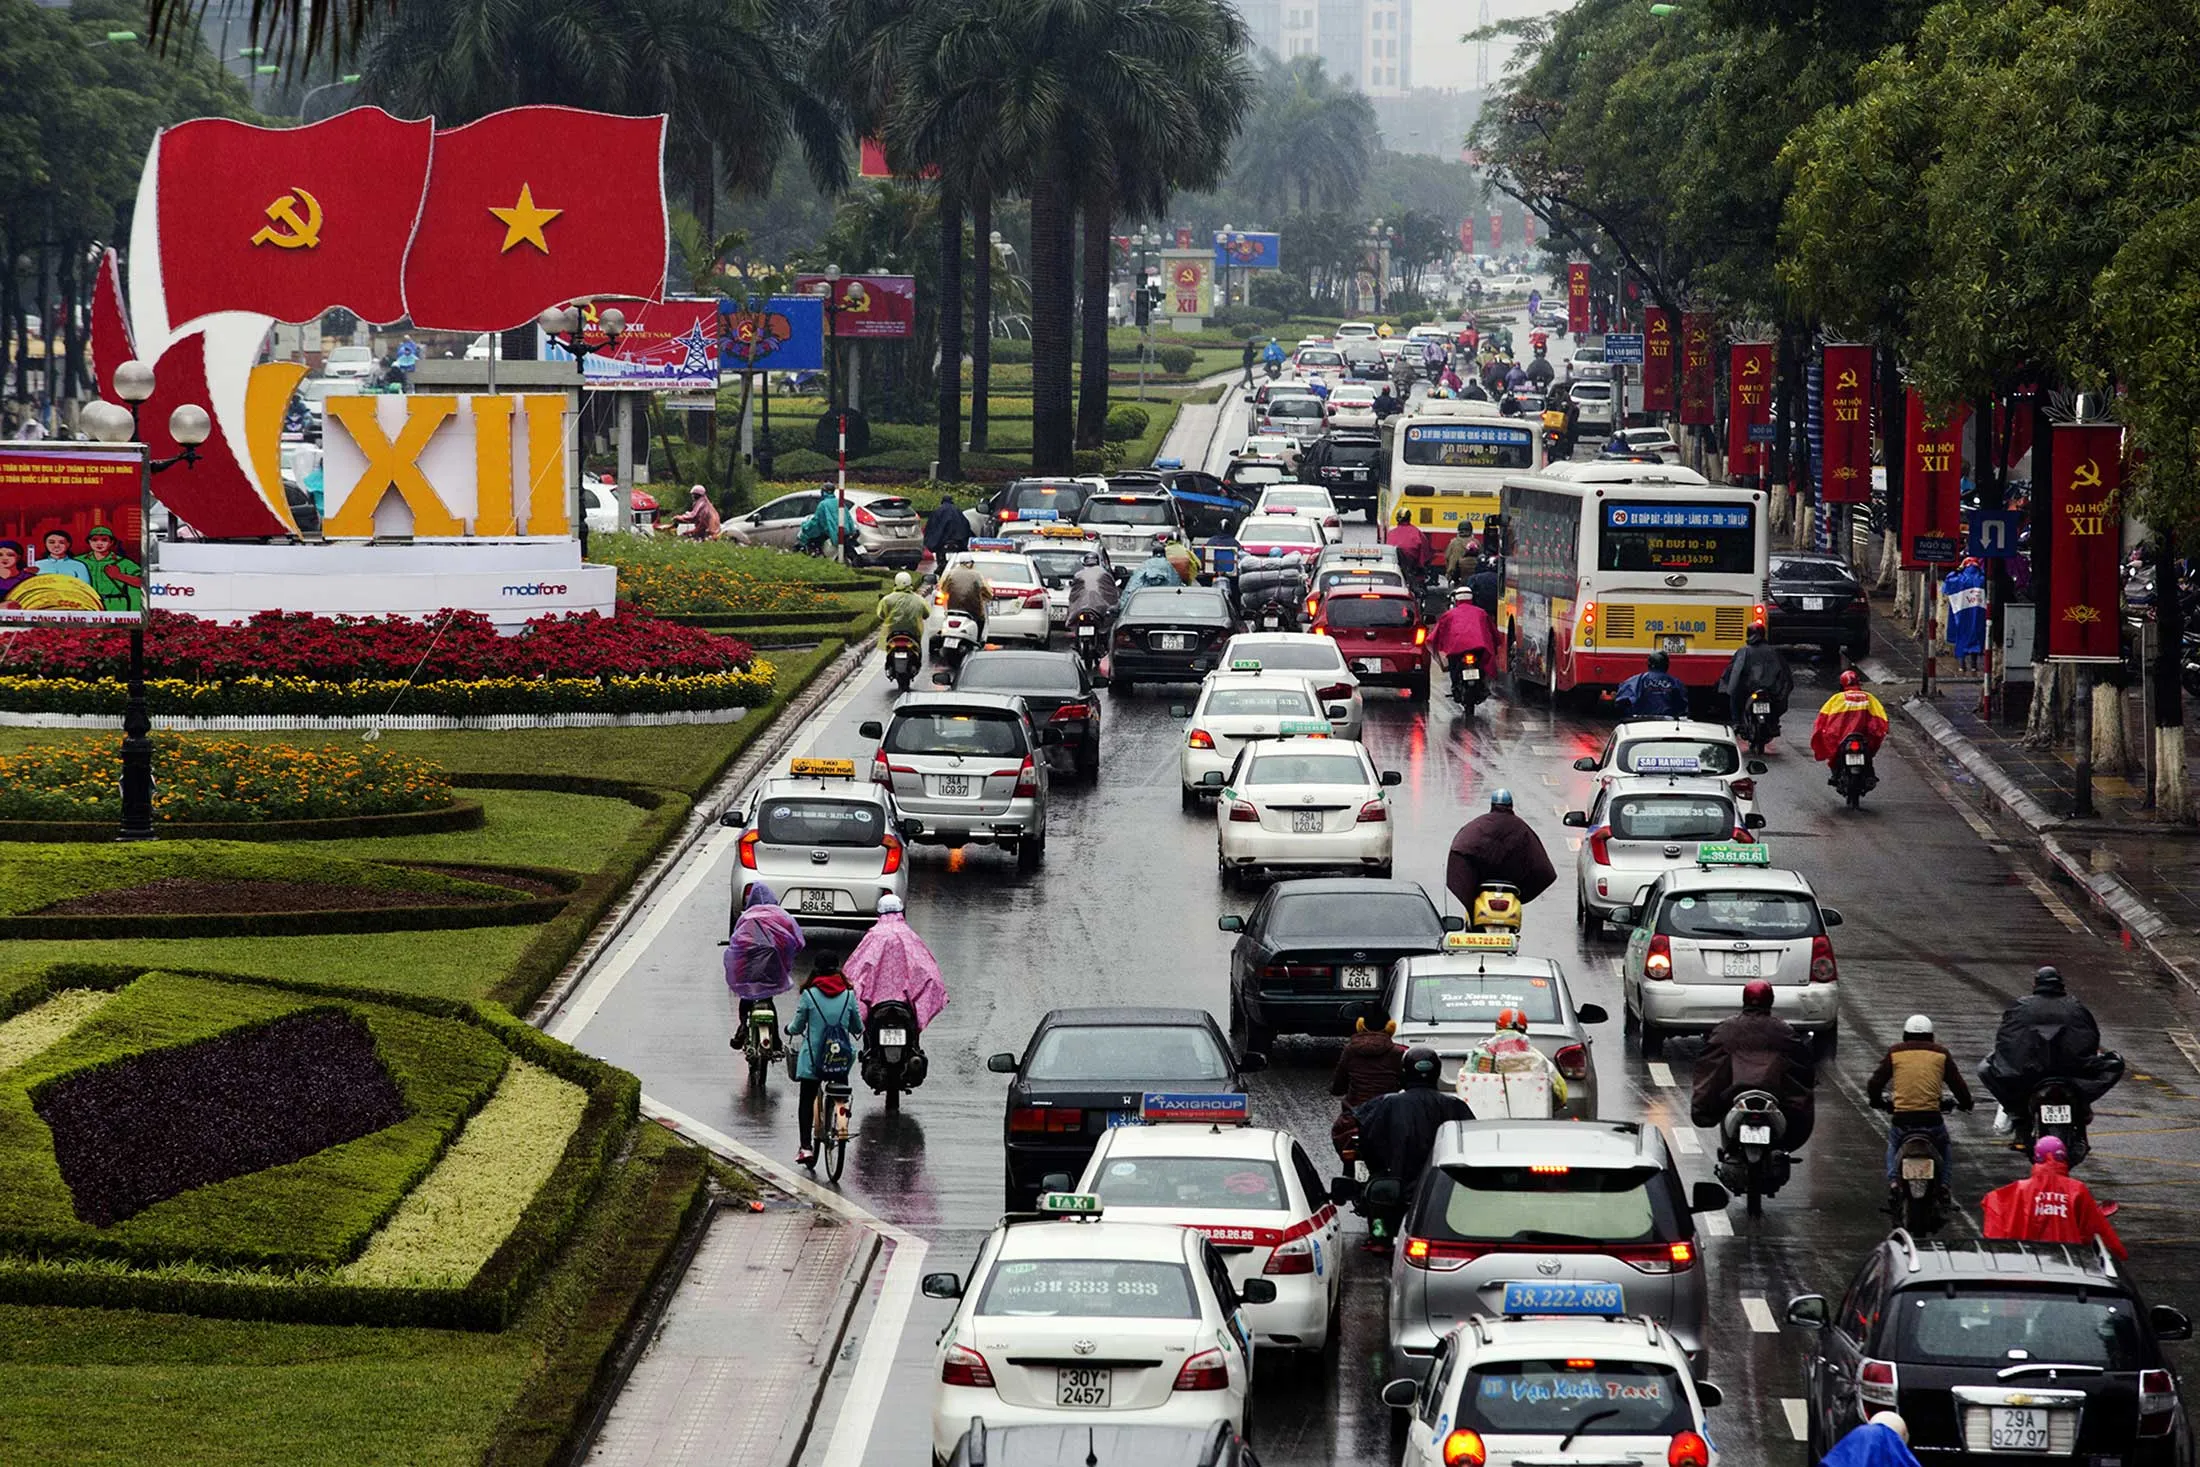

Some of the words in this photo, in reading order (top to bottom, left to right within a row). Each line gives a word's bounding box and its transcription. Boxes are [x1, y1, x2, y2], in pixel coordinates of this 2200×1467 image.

[1177, 299, 1197, 312] XII
[1651, 346, 1668, 356] XII
[1742, 393, 1760, 404] XII
[1835, 408, 1859, 421] XII
[1917, 443, 1935, 455] ĐẠI
[1937, 443, 1955, 455] HỘI
[324, 395, 570, 537] XII
[1921, 456, 1949, 472] XII
[2066, 504, 2086, 516] ĐẠI
[2089, 502, 2107, 514] HỘ
[1615, 512, 1626, 522] 29
[2070, 517, 2104, 535] XII
[148, 583, 195, 597] obifone
[503, 582, 567, 597] mobifone
[1645, 620, 1664, 631] 29B
[1674, 620, 1706, 632] 140.00
[1640, 758, 1657, 767] SAO
[809, 891, 826, 901] 30A
[1349, 966, 1370, 977] 29L
[1348, 977, 1371, 987] 4814
[1159, 1100, 1243, 1109] TAXIGROUP
[1068, 1281, 1109, 1293] 333
[1117, 1282, 1158, 1295] 333
[1511, 1288, 1616, 1308] 38.222.888
[1069, 1370, 1100, 1387] 30Y
[1064, 1388, 1106, 1404] 2457
[1605, 1382, 1659, 1400] Taxi
[2005, 1411, 2035, 1428] 29A
[1993, 1429, 2047, 1447] 927.97
